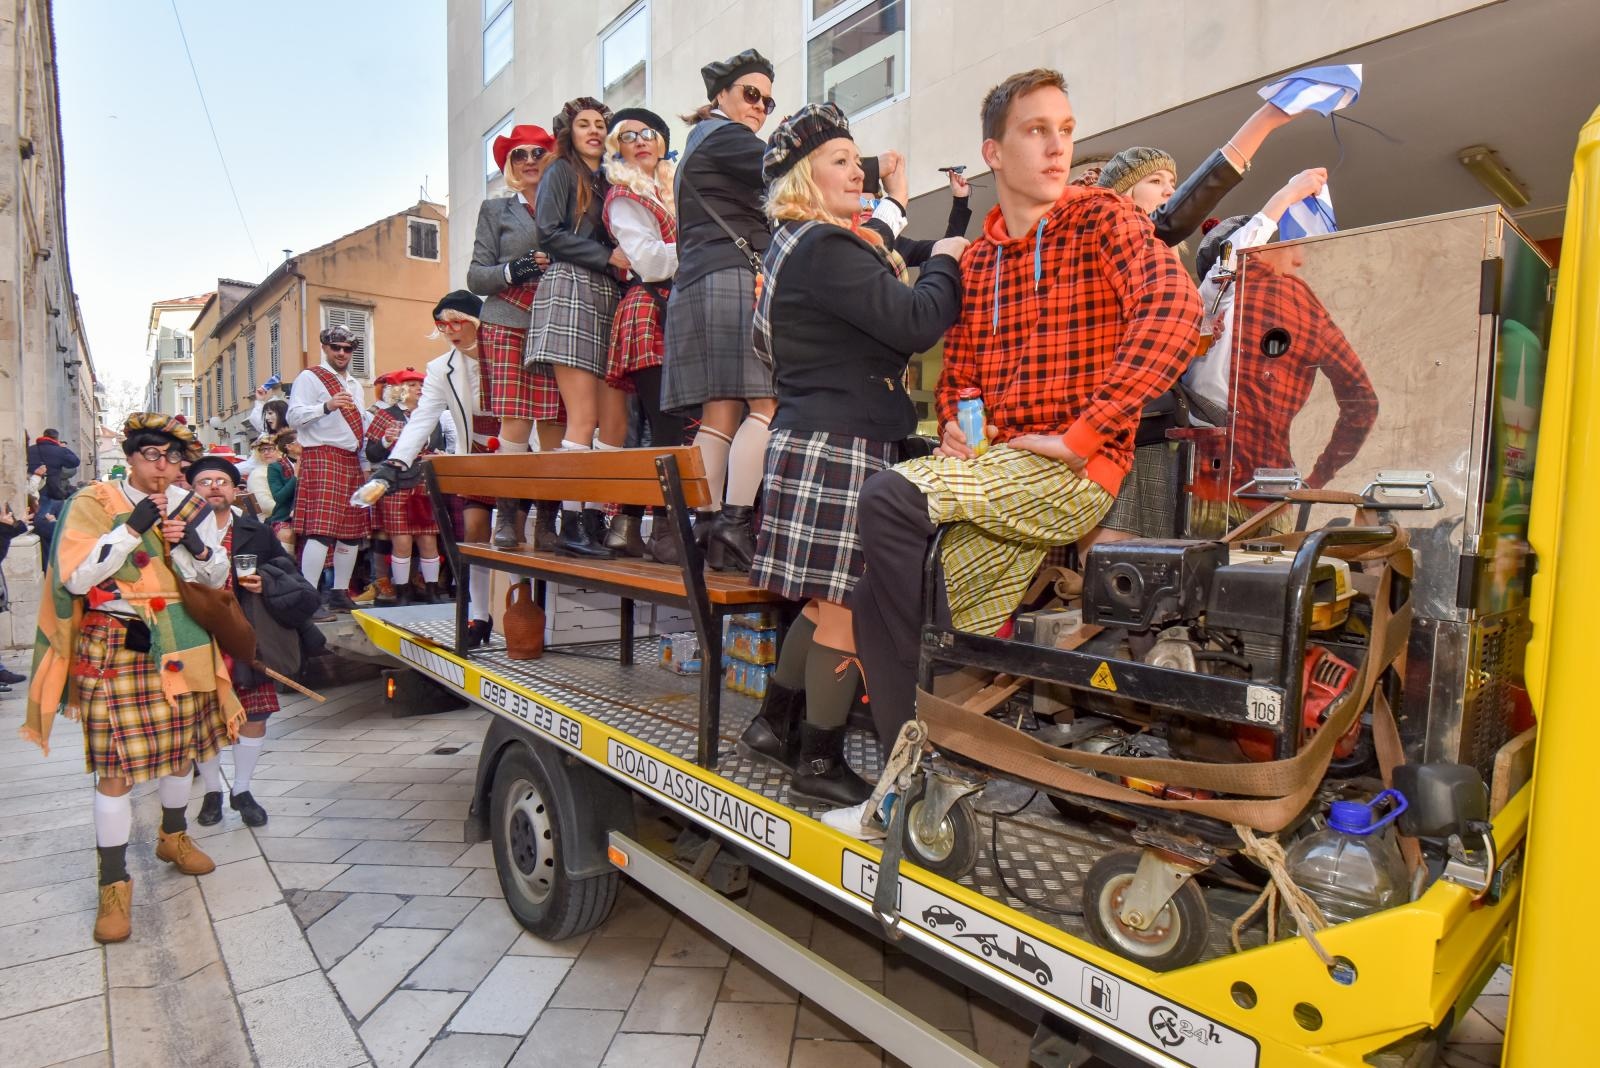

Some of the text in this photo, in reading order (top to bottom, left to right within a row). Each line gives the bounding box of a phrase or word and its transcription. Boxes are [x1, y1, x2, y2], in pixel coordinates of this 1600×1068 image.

[483, 681, 579, 745] 098 33 23 68
[616, 745, 776, 847] ROAD ASSISTANCE
[1179, 1020, 1222, 1046] 24h
